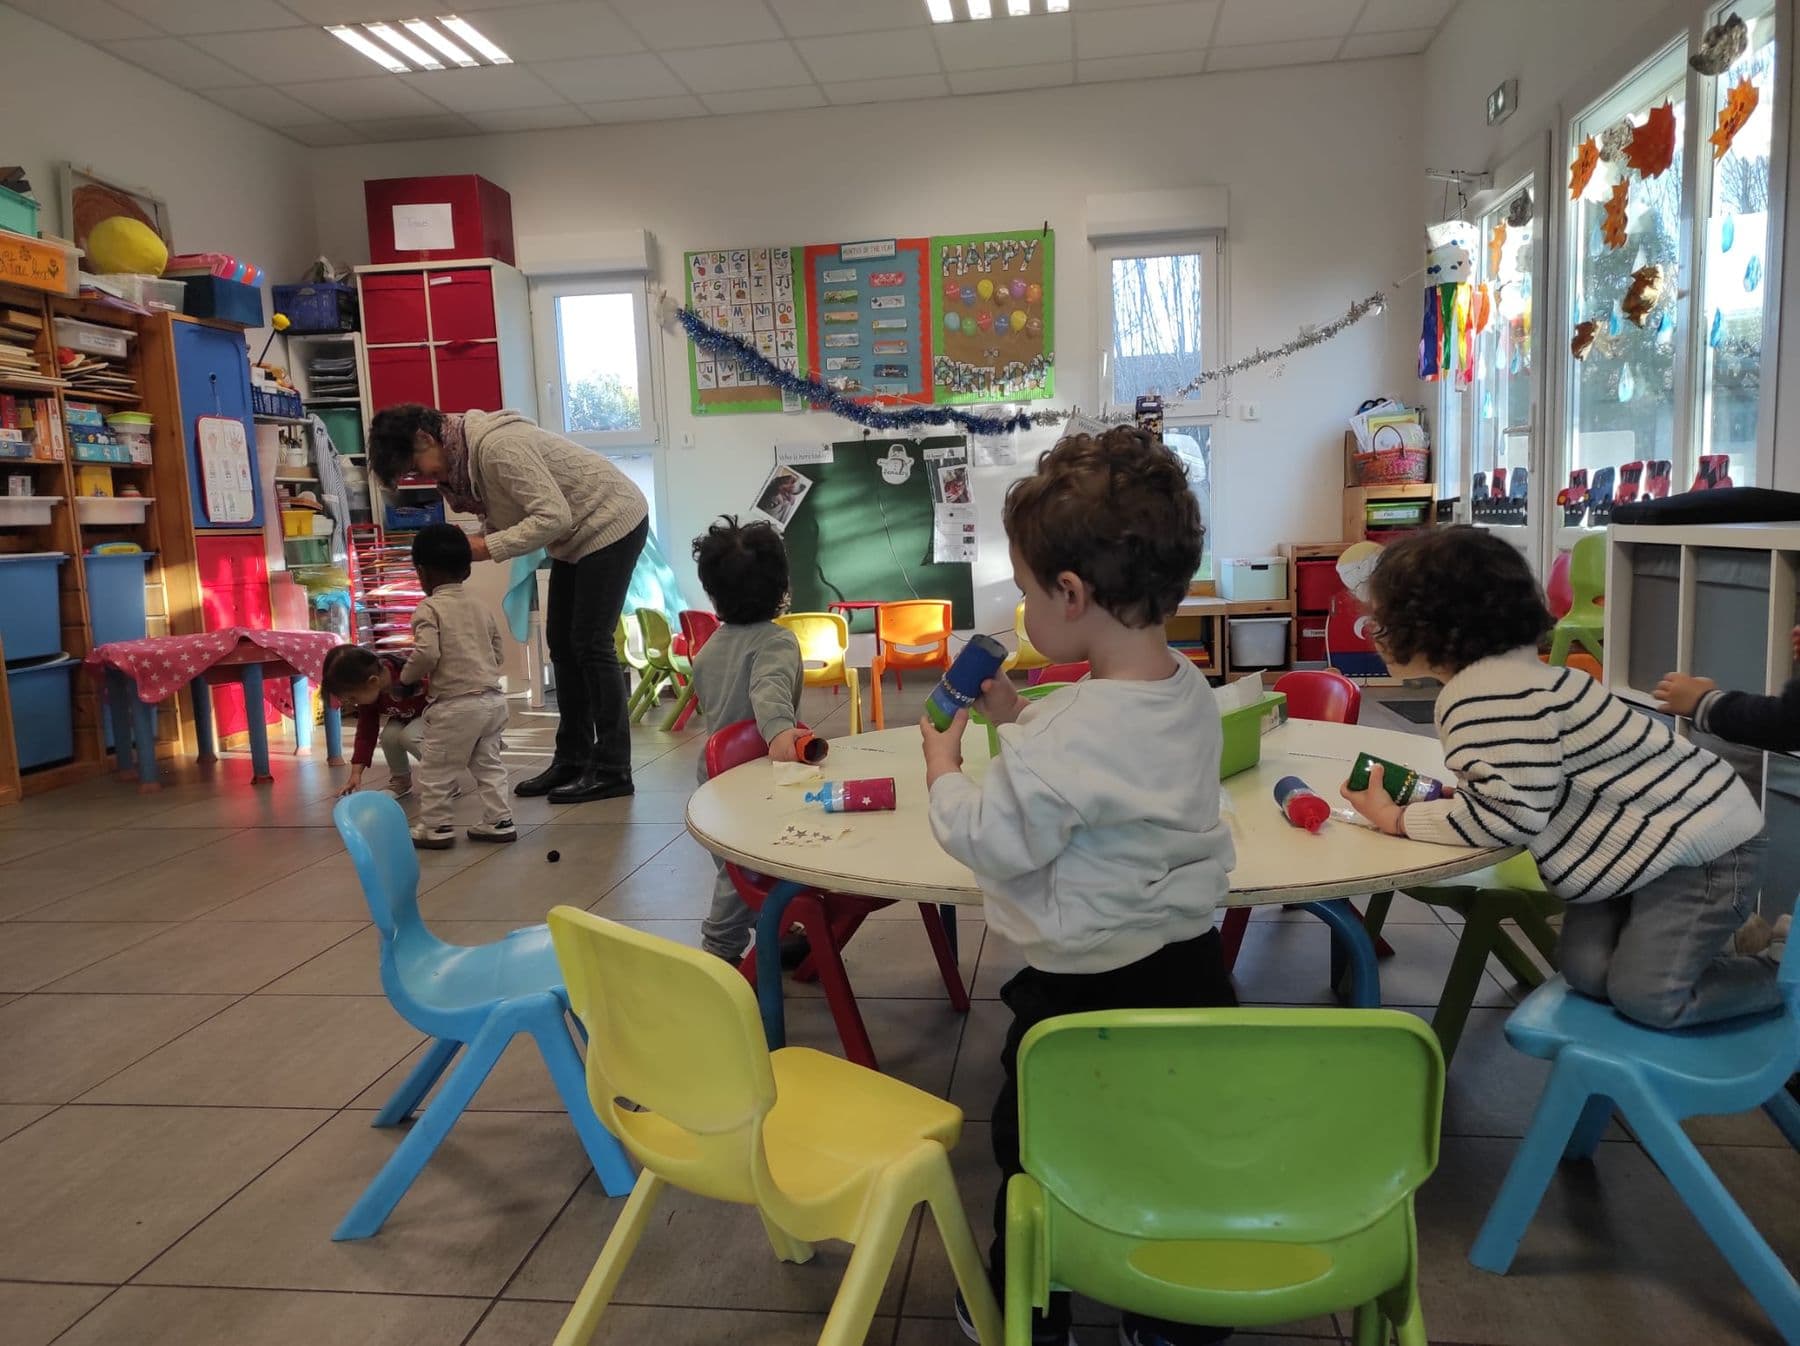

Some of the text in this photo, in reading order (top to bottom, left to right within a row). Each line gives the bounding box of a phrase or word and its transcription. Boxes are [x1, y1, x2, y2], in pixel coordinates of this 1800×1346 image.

[711, 253, 726, 263] Bb
[731, 252, 746, 262] Cc
[773, 248, 788, 259] Ee
[942, 239, 1038, 277] HAPPY
[693, 256, 707, 266] Aa
[693, 281, 708, 292] Ff
[733, 278, 747, 289] Hh
[776, 275, 790, 289] Jj
[755, 305, 770, 316] Nn
[777, 303, 792, 313] Oo
[781, 331, 794, 340] Tt
[698, 363, 713, 373] Uu
[719, 362, 734, 372] Vv
[782, 359, 796, 372] Yy
[934, 352, 1055, 397] BIRTHDAY
